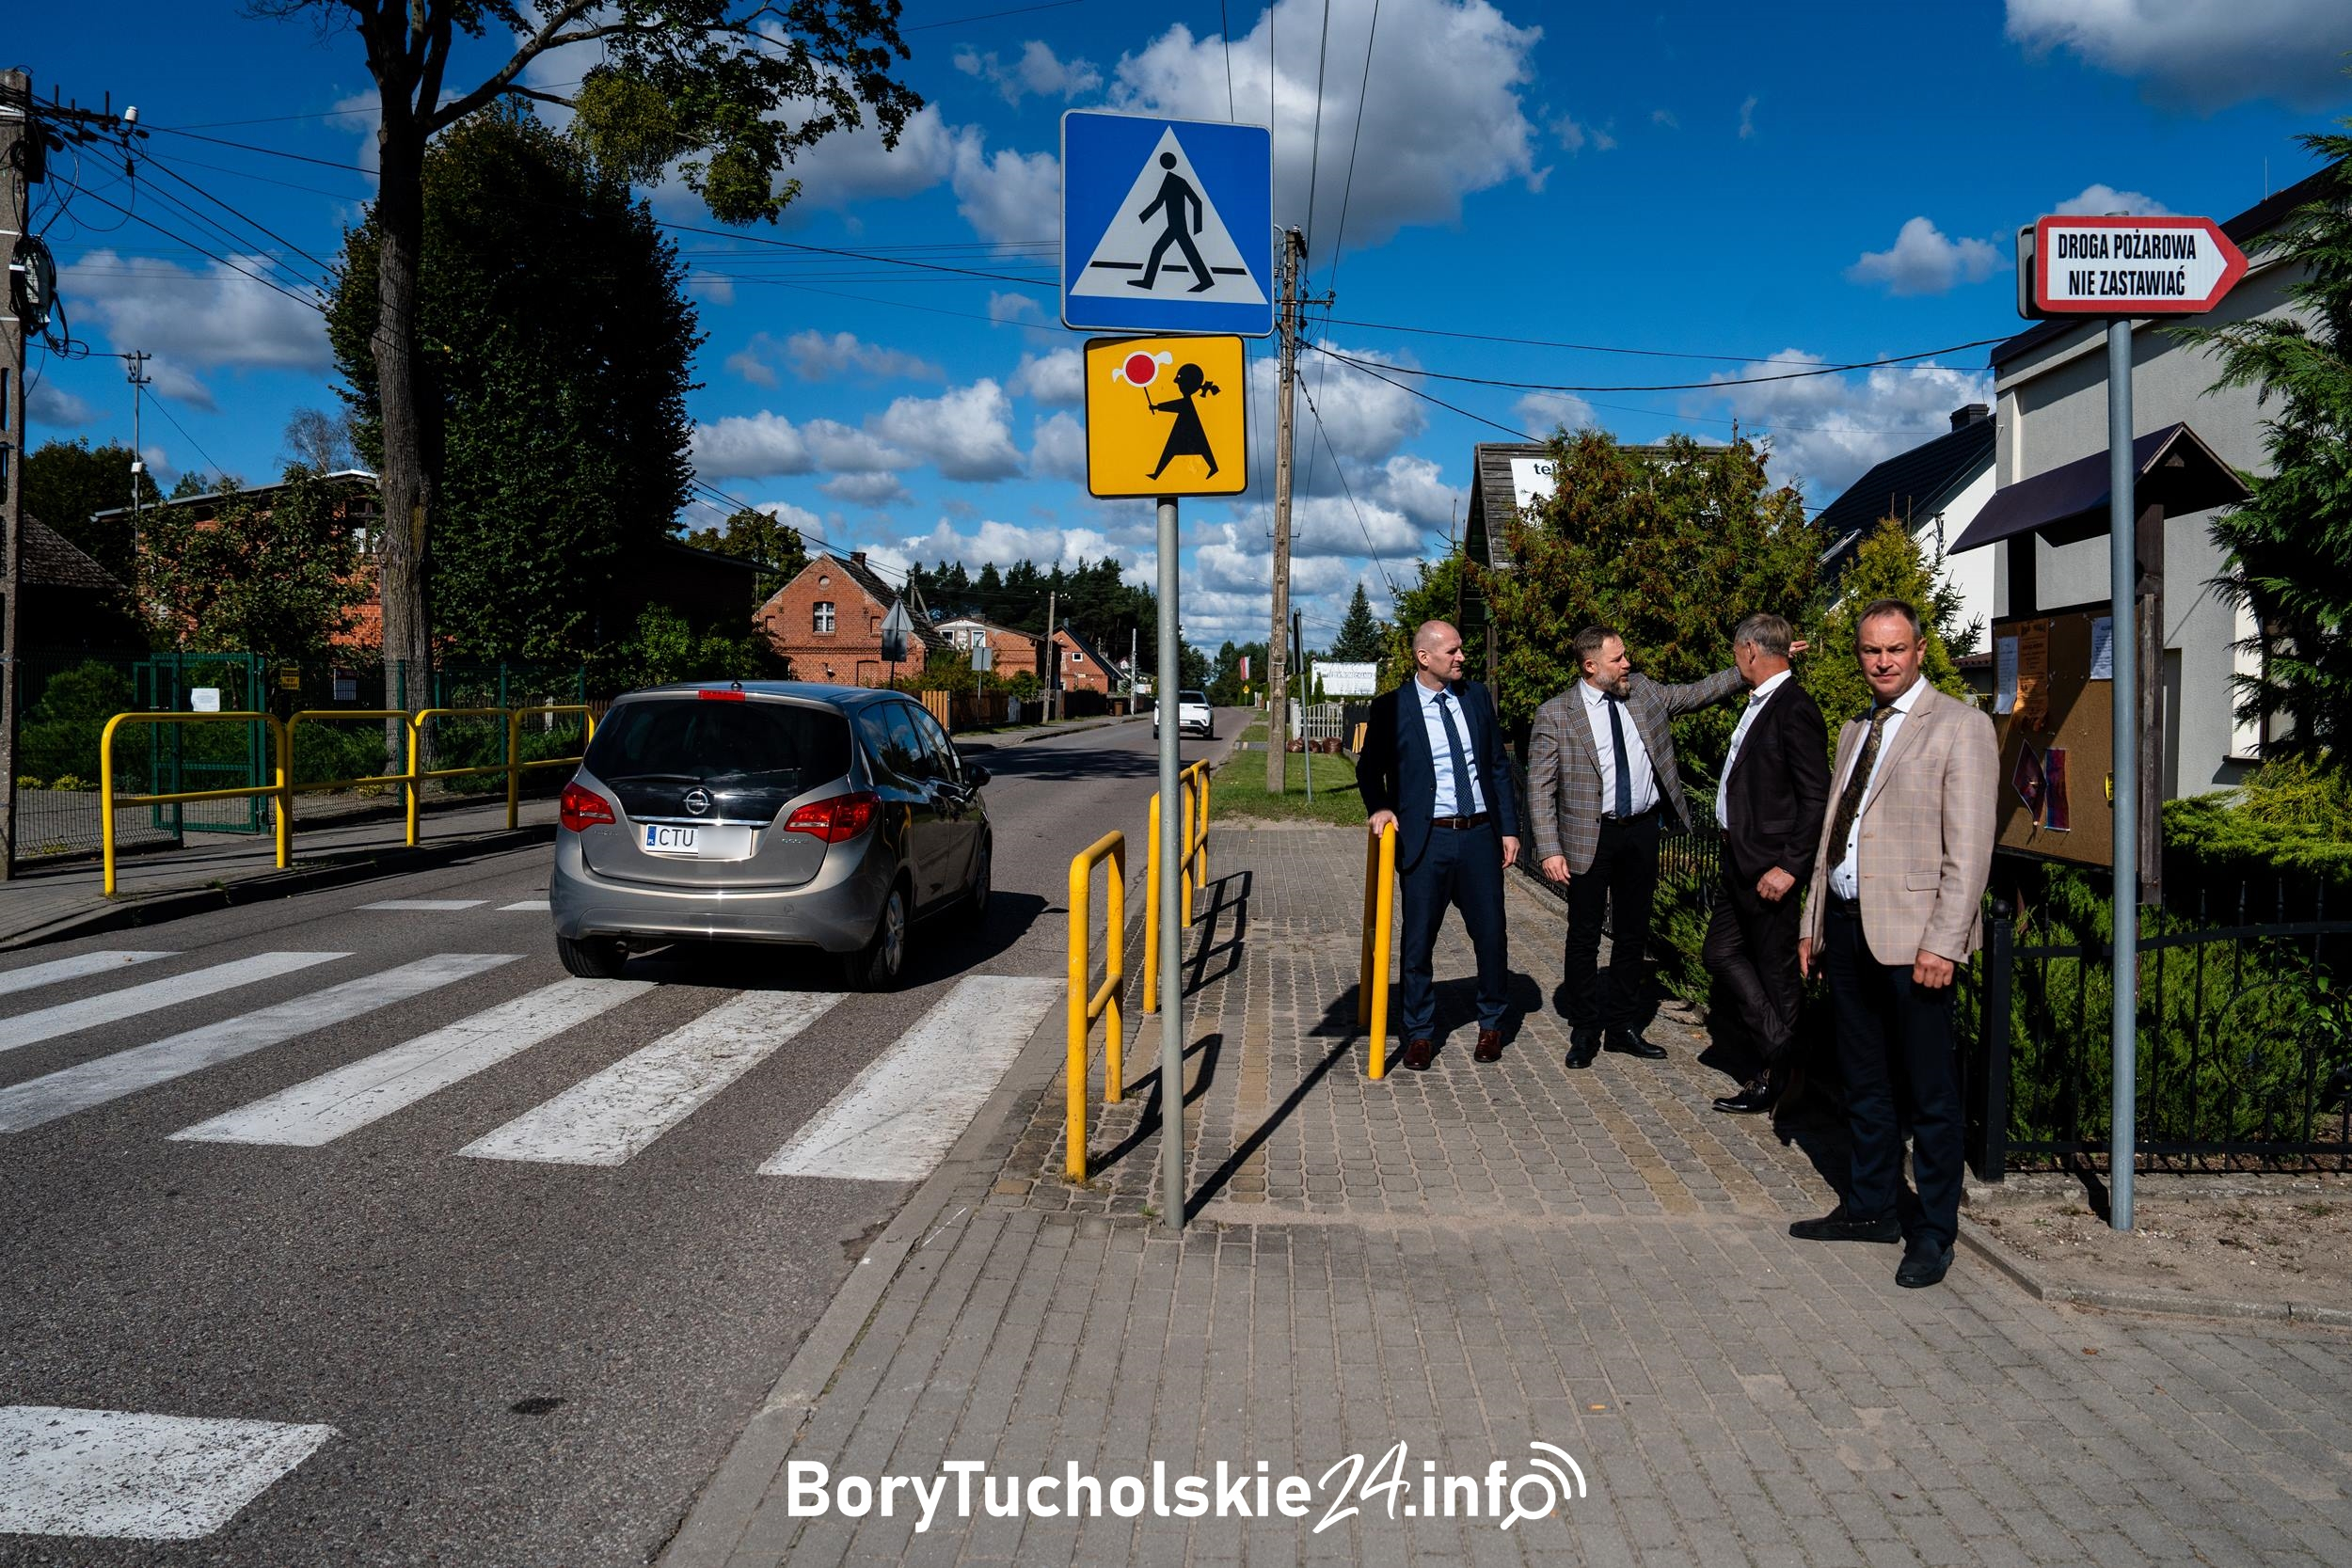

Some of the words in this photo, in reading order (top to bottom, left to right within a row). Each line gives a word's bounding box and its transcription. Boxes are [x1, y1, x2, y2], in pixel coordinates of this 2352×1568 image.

[2058, 233, 2108, 259] DROGA
[2114, 229, 2197, 260] POŻAROWA
[2069, 271, 2095, 295] NIE
[2100, 265, 2185, 296] ZASTAWIAĆ
[659, 829, 694, 847] CTU
